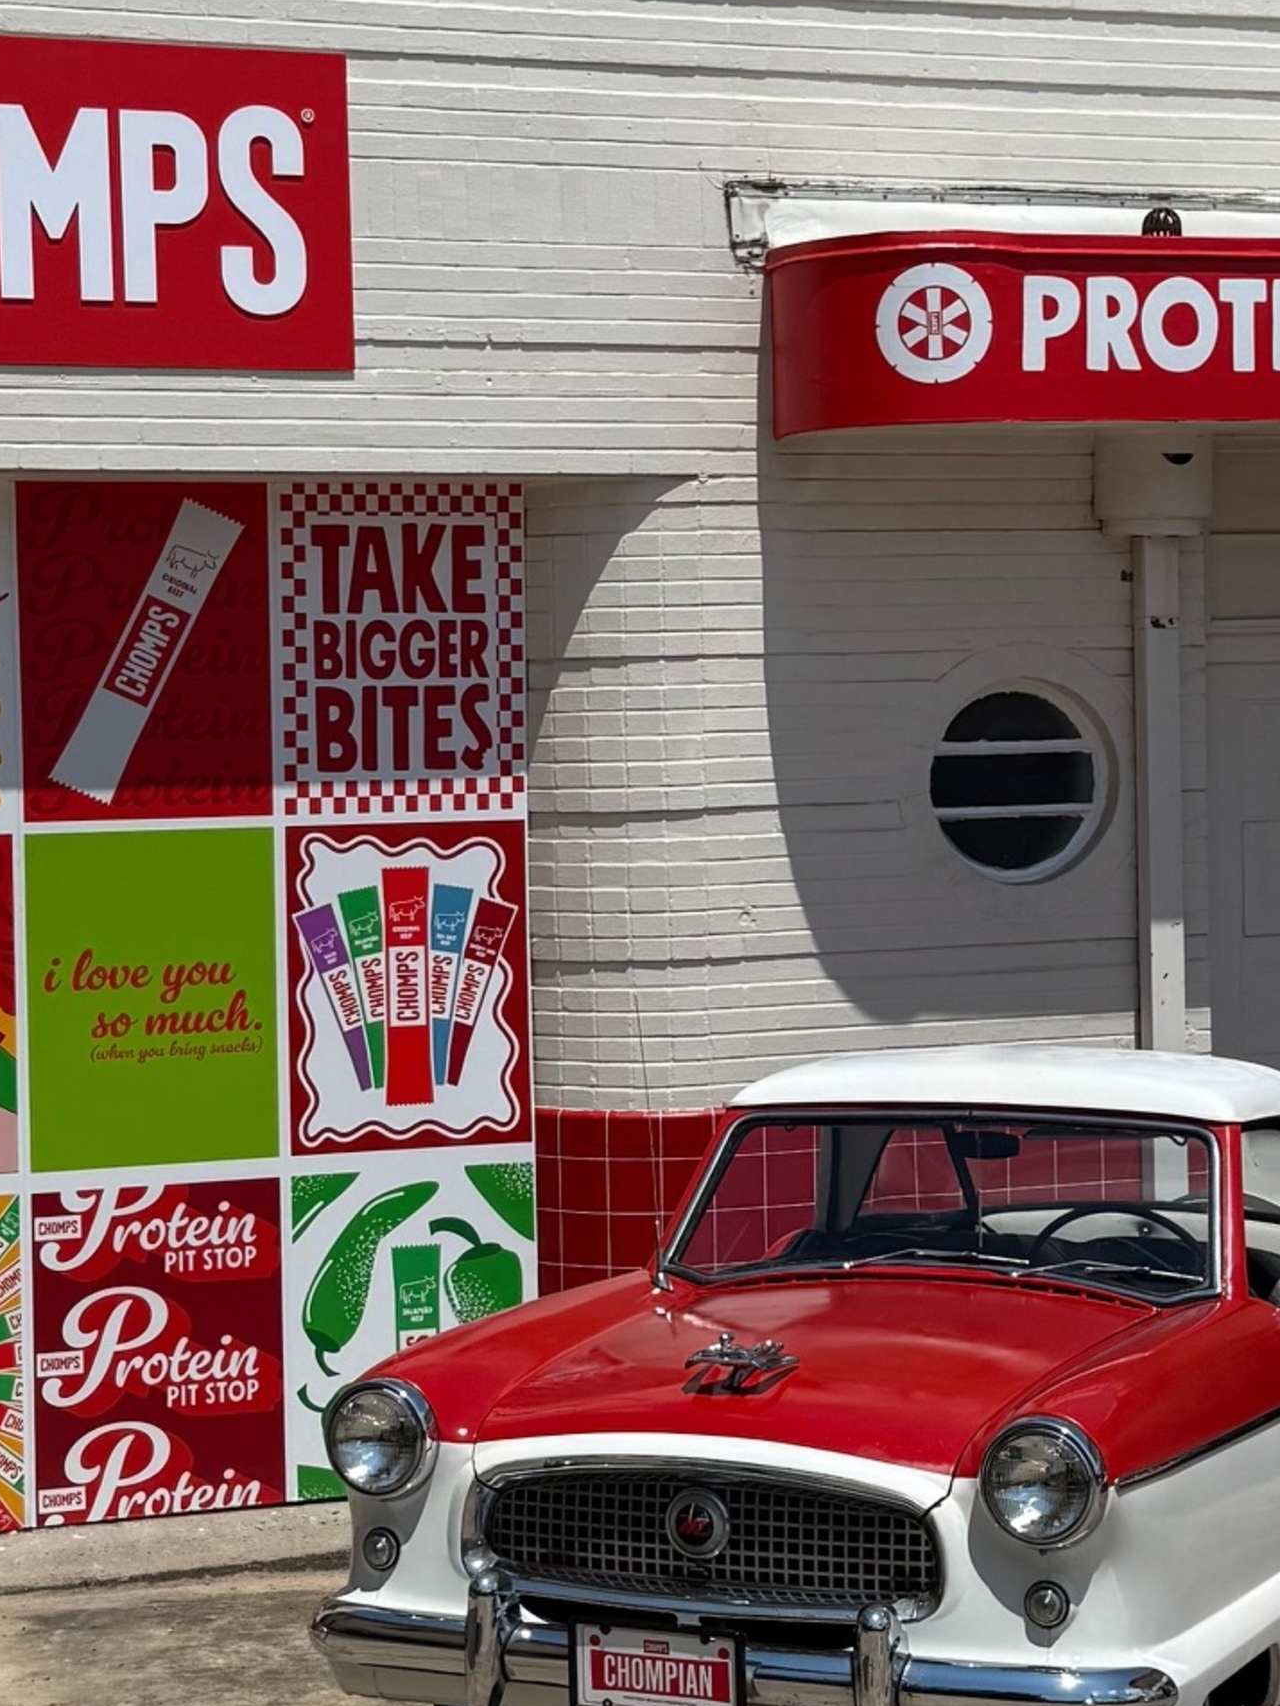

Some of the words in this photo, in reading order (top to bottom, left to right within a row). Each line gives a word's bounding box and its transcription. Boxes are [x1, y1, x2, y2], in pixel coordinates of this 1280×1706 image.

[311, 523, 487, 614] TAKE
[114, 605, 181, 698] CHOMPS
[313, 619, 490, 680] BIGGER
[315, 683, 493, 773] BITES
[44, 957, 61, 993] i
[72, 948, 152, 992] love
[160, 961, 236, 1004] you
[328, 969, 361, 1026] CHOMPS
[361, 957, 384, 1018] CHOMPS
[395, 951, 420, 1021] CHOMPS
[432, 955, 453, 1015] CHOMPS
[455, 964, 485, 1021] CHOMPS
[91, 1012, 138, 1038] so
[145, 990, 263, 1036] much.
[137, 1047, 165, 1063] you
[169, 1041, 206, 1061] bring
[38, 1219, 79, 1236] CHOMPS
[40, 1184, 257, 1272] Protein
[164, 1250, 196, 1273] PIT
[203, 1245, 257, 1271] STOP
[40, 1356, 81, 1373] CHOMPS
[42, 1285, 260, 1408] Protein
[166, 1384, 198, 1408] PIT
[205, 1379, 259, 1404] STOP
[42, 1491, 83, 1509] CHOMPS
[44, 1420, 262, 1527] Protein
[604, 1655, 713, 1698] CHOMPIAN
